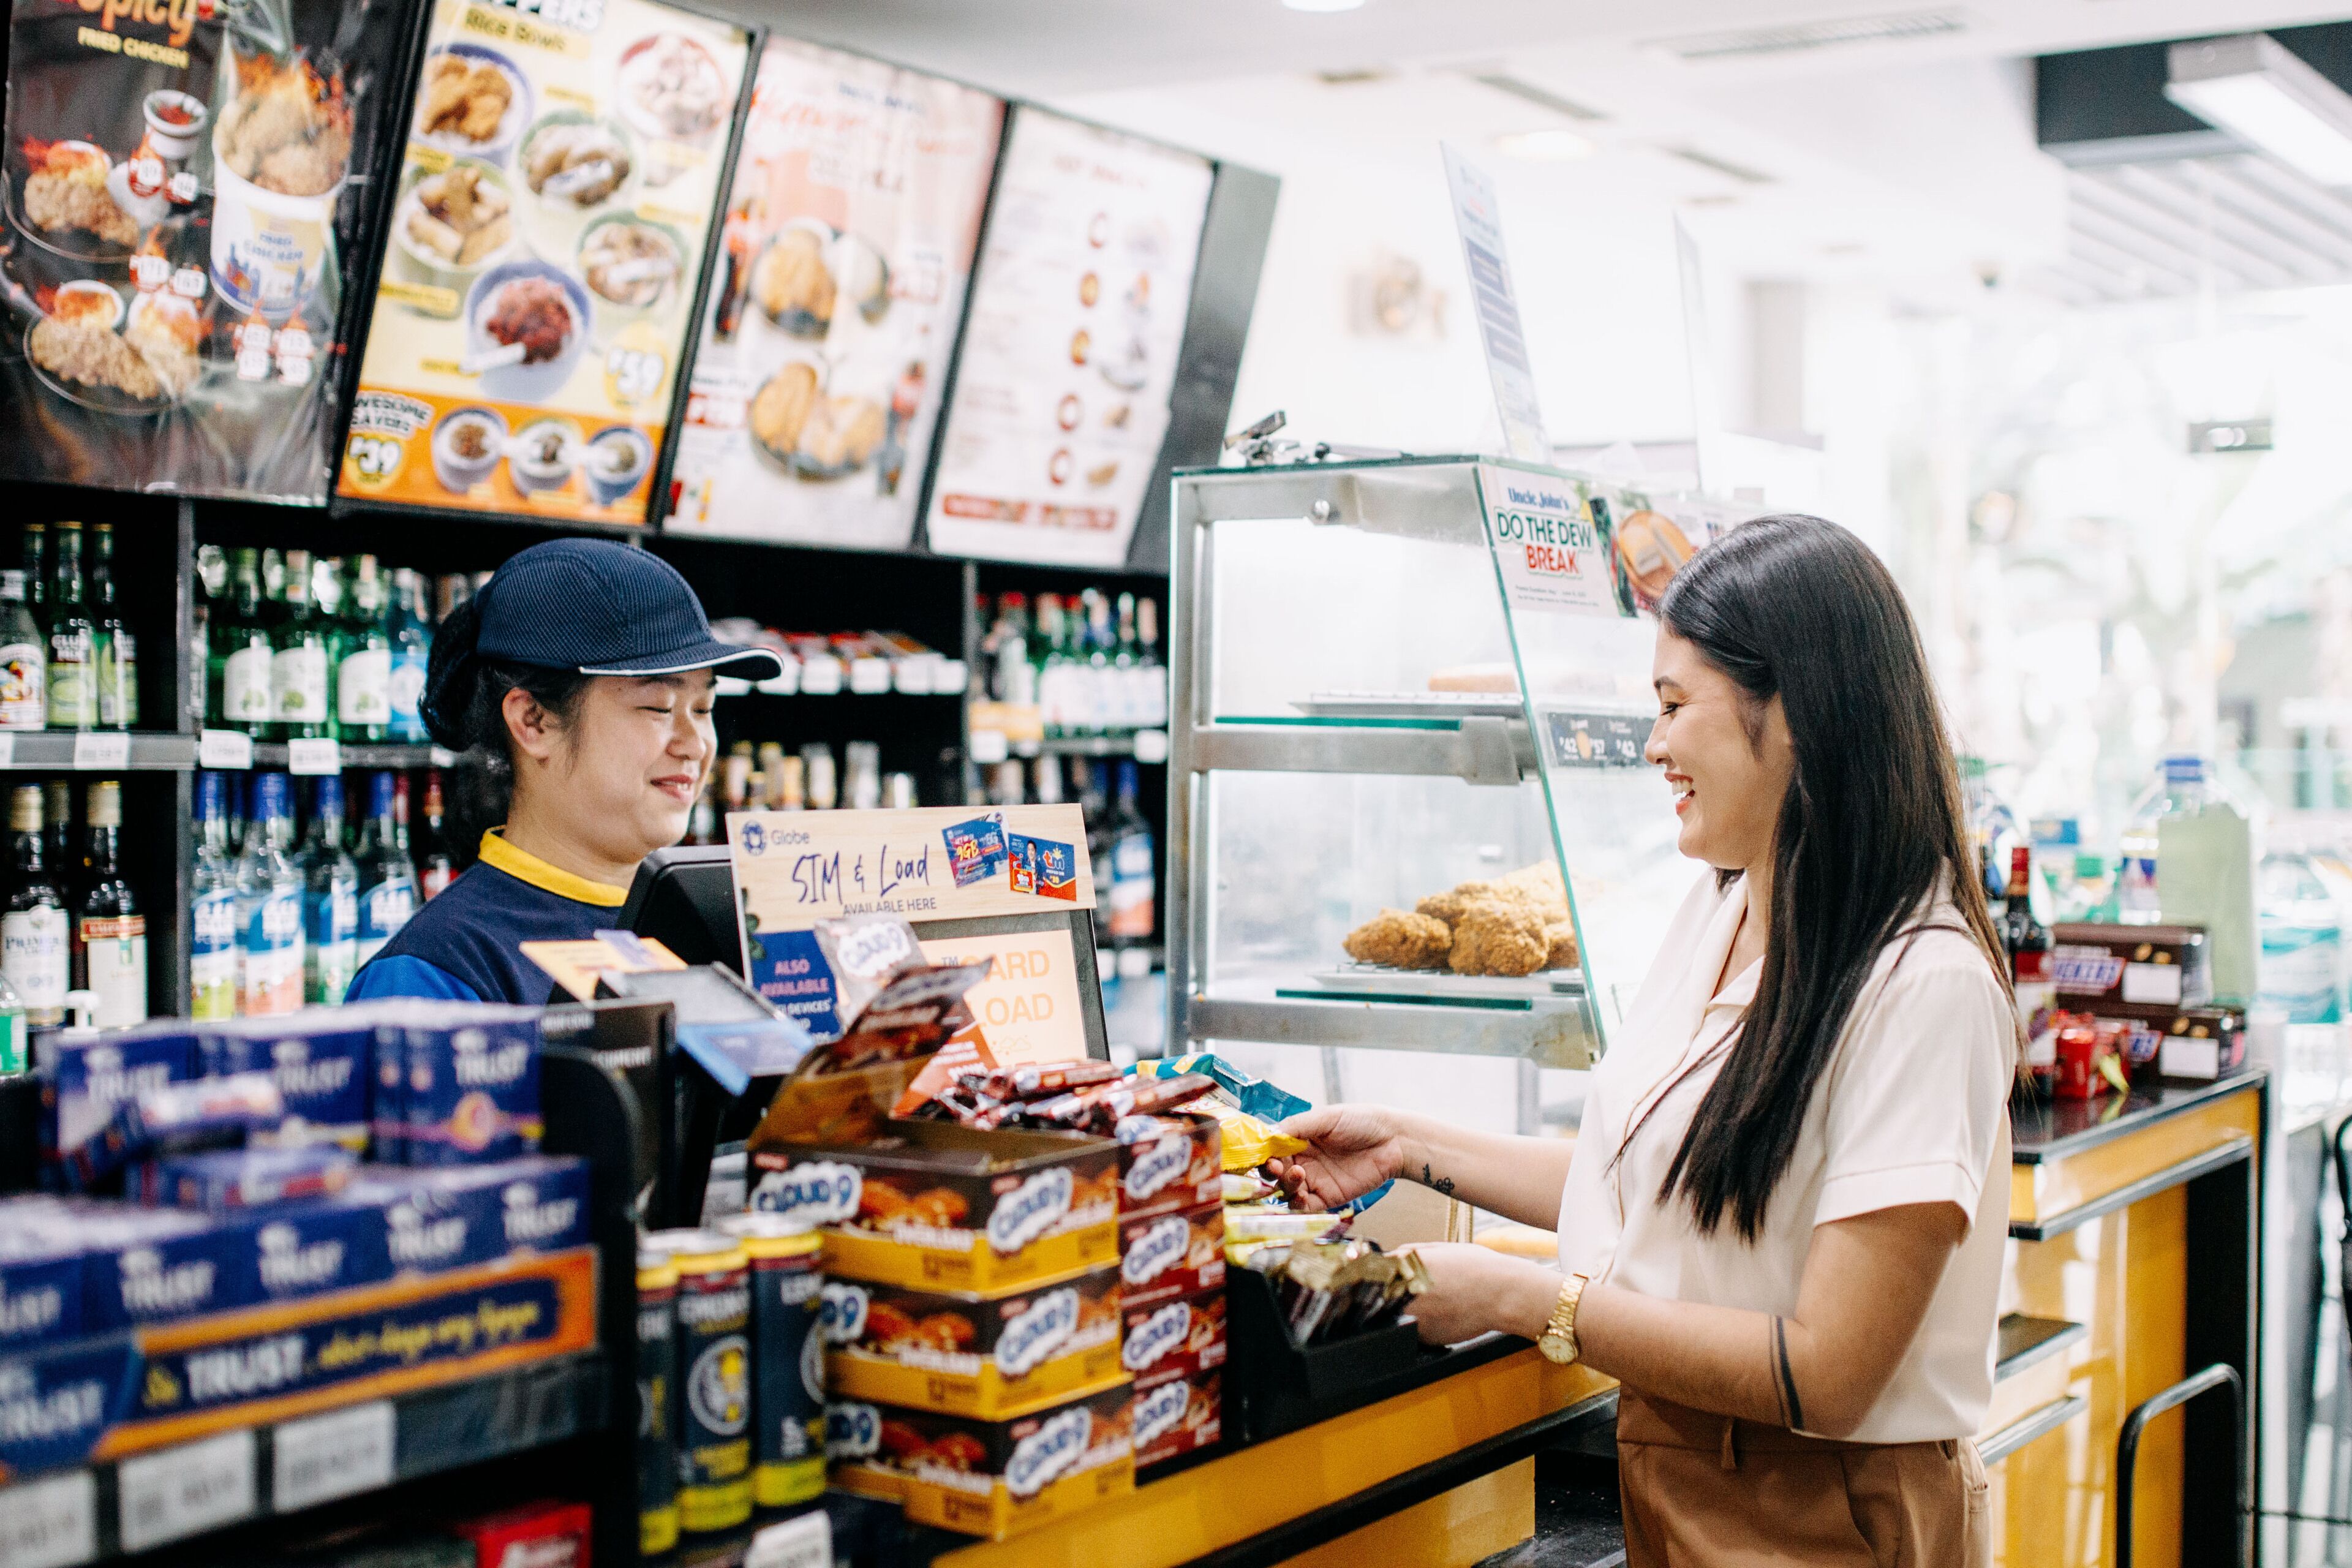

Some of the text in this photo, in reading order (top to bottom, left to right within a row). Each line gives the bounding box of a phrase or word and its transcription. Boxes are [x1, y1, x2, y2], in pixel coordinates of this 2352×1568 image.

[78, 0, 197, 47] picy
[78, 26, 190, 69] FRIED CHICKEN
[1507, 487, 1570, 510] Uncle John's
[1497, 511, 1593, 548] DO THE DEW
[1526, 544, 1579, 574] BREAK
[771, 829, 810, 845] Globe
[792, 843, 930, 905] SIM & Load
[842, 897, 937, 915] AVAILABLE HERE
[774, 958, 811, 976] ALSO
[760, 977, 829, 997] AVAILABLE
[978, 992, 1055, 1028] OAD
[454, 1041, 529, 1085] TRUST
[186, 1333, 306, 1403] TRUST
